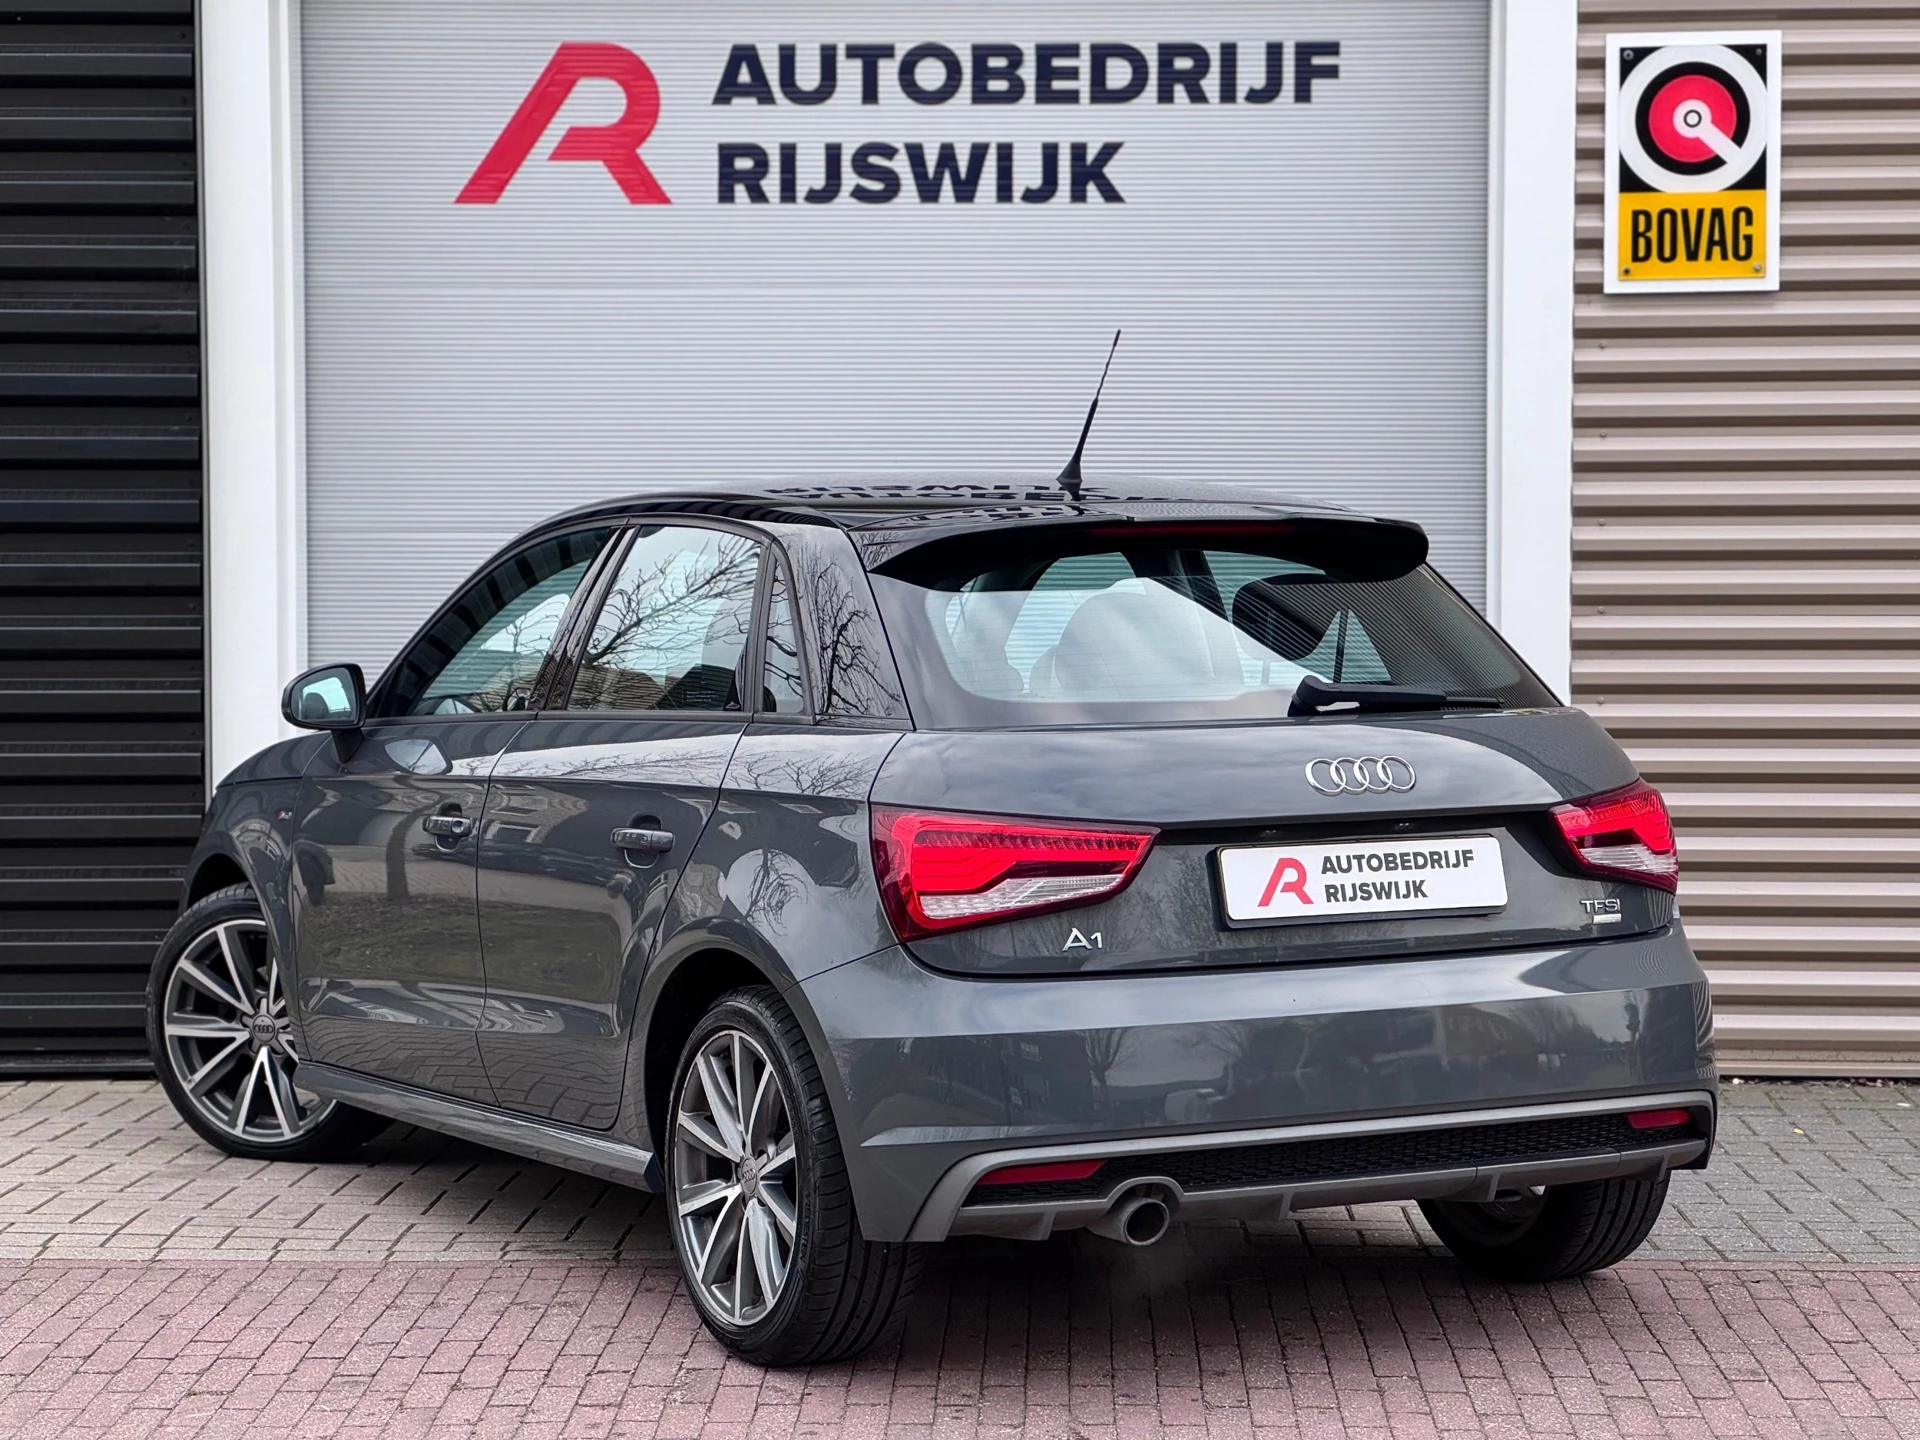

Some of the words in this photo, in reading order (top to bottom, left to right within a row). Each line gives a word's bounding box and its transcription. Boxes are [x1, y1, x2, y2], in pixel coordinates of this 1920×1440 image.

[713, 42, 1340, 105] AUTOBEDRIJF
[718, 143, 1124, 204] RIJSWIJK
[1631, 206, 1754, 263] BOVAG
[1321, 849, 1474, 875] AUTOBEDRIJF
[1325, 879, 1428, 903] RIJSWIJK
[1580, 898, 1621, 913] TFSI
[1061, 926, 1104, 951] A1
